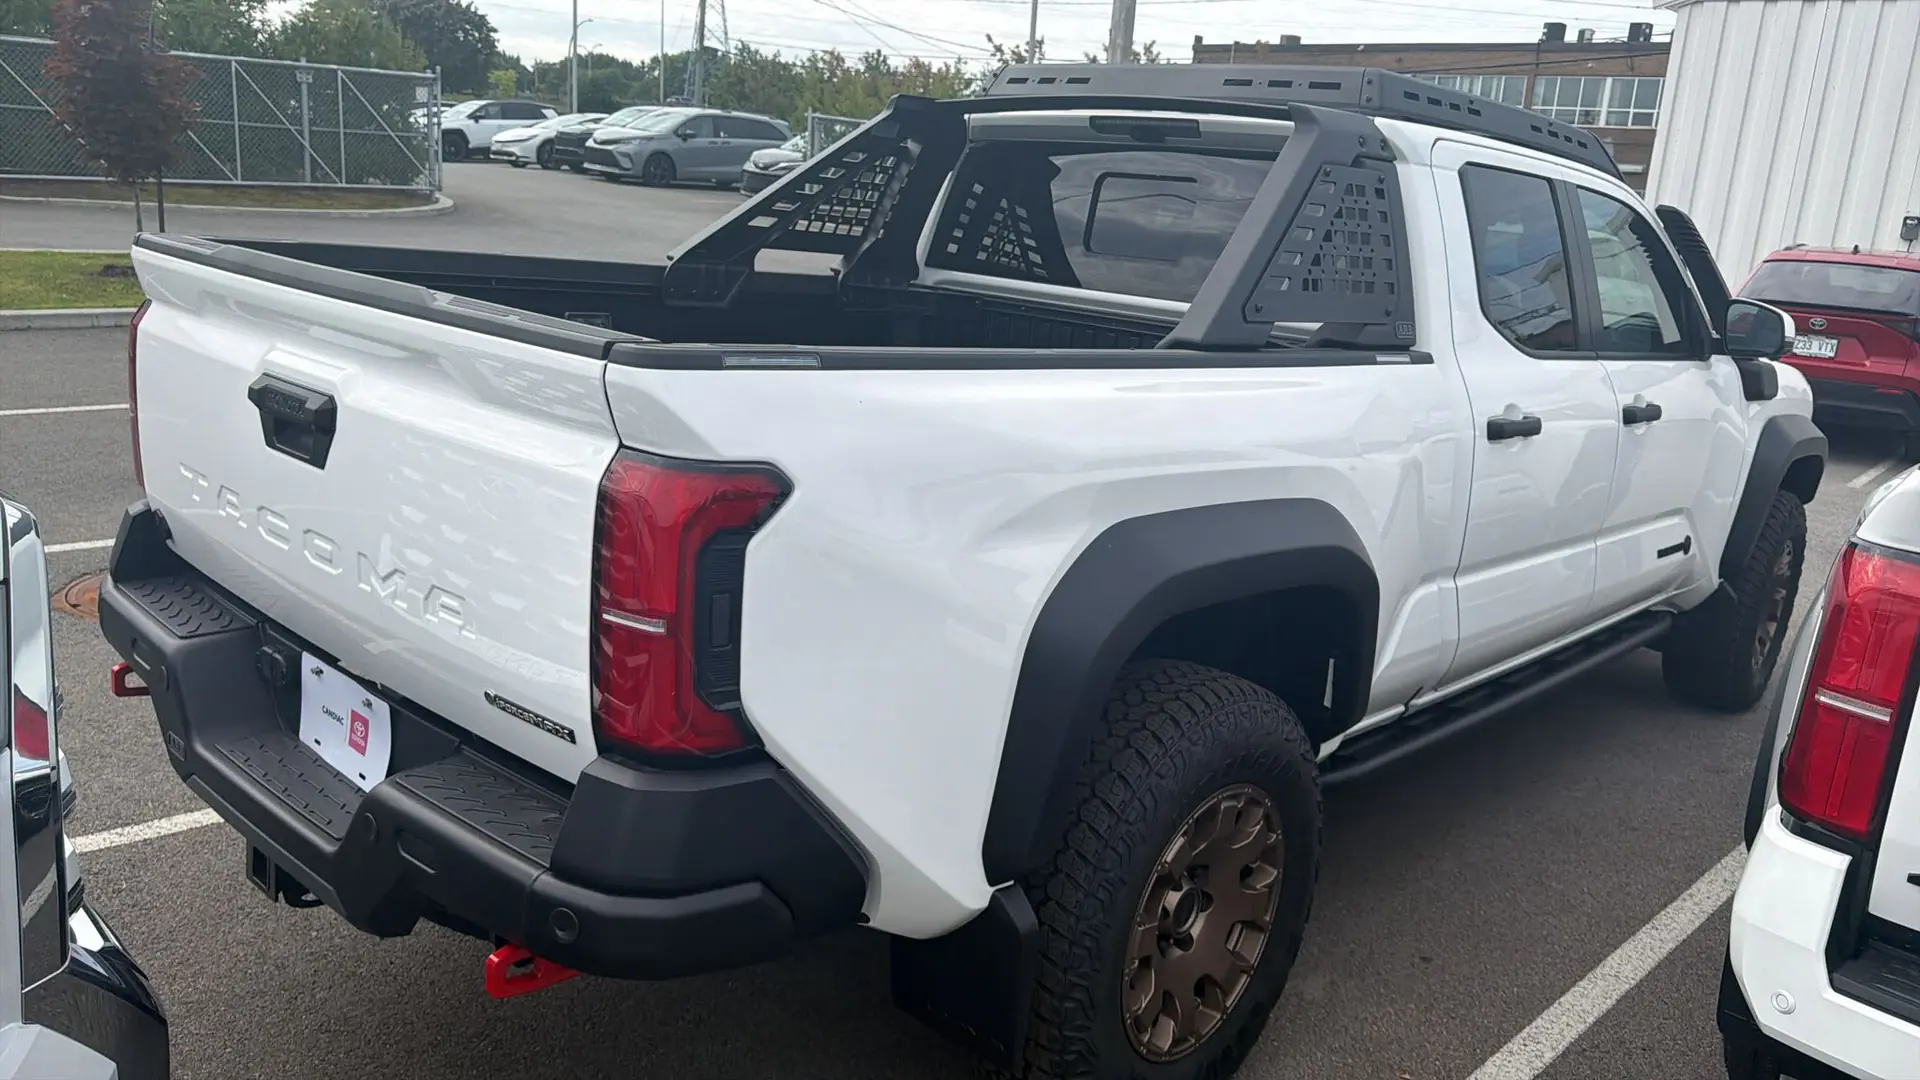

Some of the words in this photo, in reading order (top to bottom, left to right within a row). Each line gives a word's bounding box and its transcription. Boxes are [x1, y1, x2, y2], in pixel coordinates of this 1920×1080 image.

[1794, 339, 1812, 351] 233
[1818, 340, 1836, 353] VTX
[179, 462, 477, 640] TACOMA
[321, 704, 345, 726] CANDIAC
